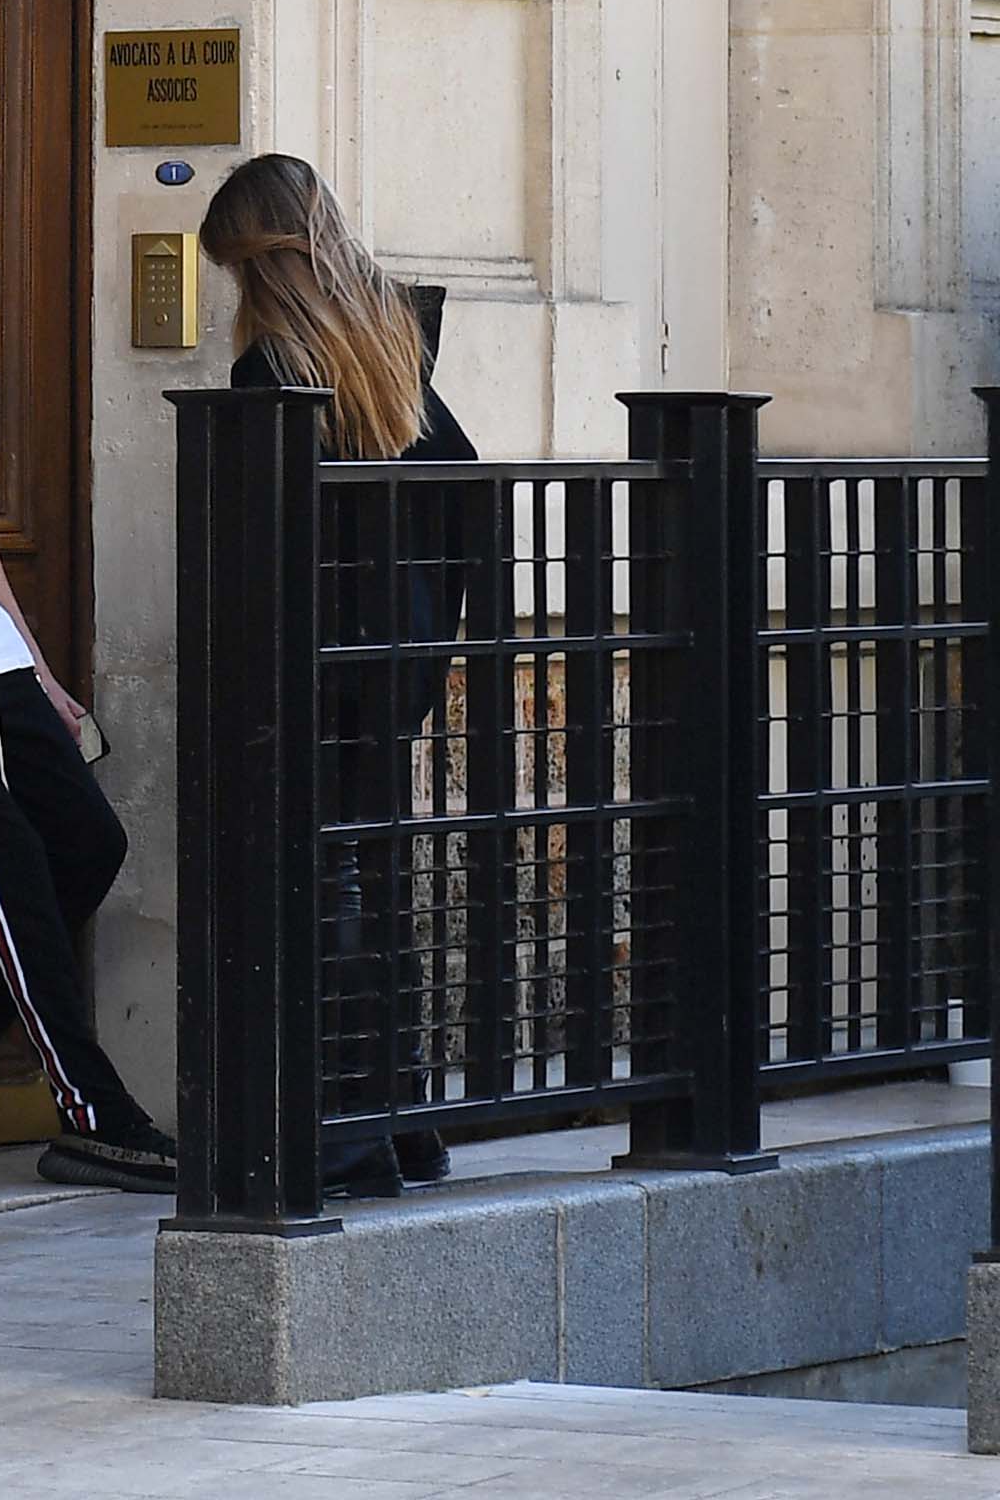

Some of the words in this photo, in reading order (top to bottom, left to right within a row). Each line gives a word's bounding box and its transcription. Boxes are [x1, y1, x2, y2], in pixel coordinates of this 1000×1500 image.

[110, 42, 160, 66] AVOCATS
[167, 42, 175, 65] A
[182, 41, 197, 65] LA
[203, 40, 235, 65] COUR
[147, 77, 197, 102] ASSOCIES
